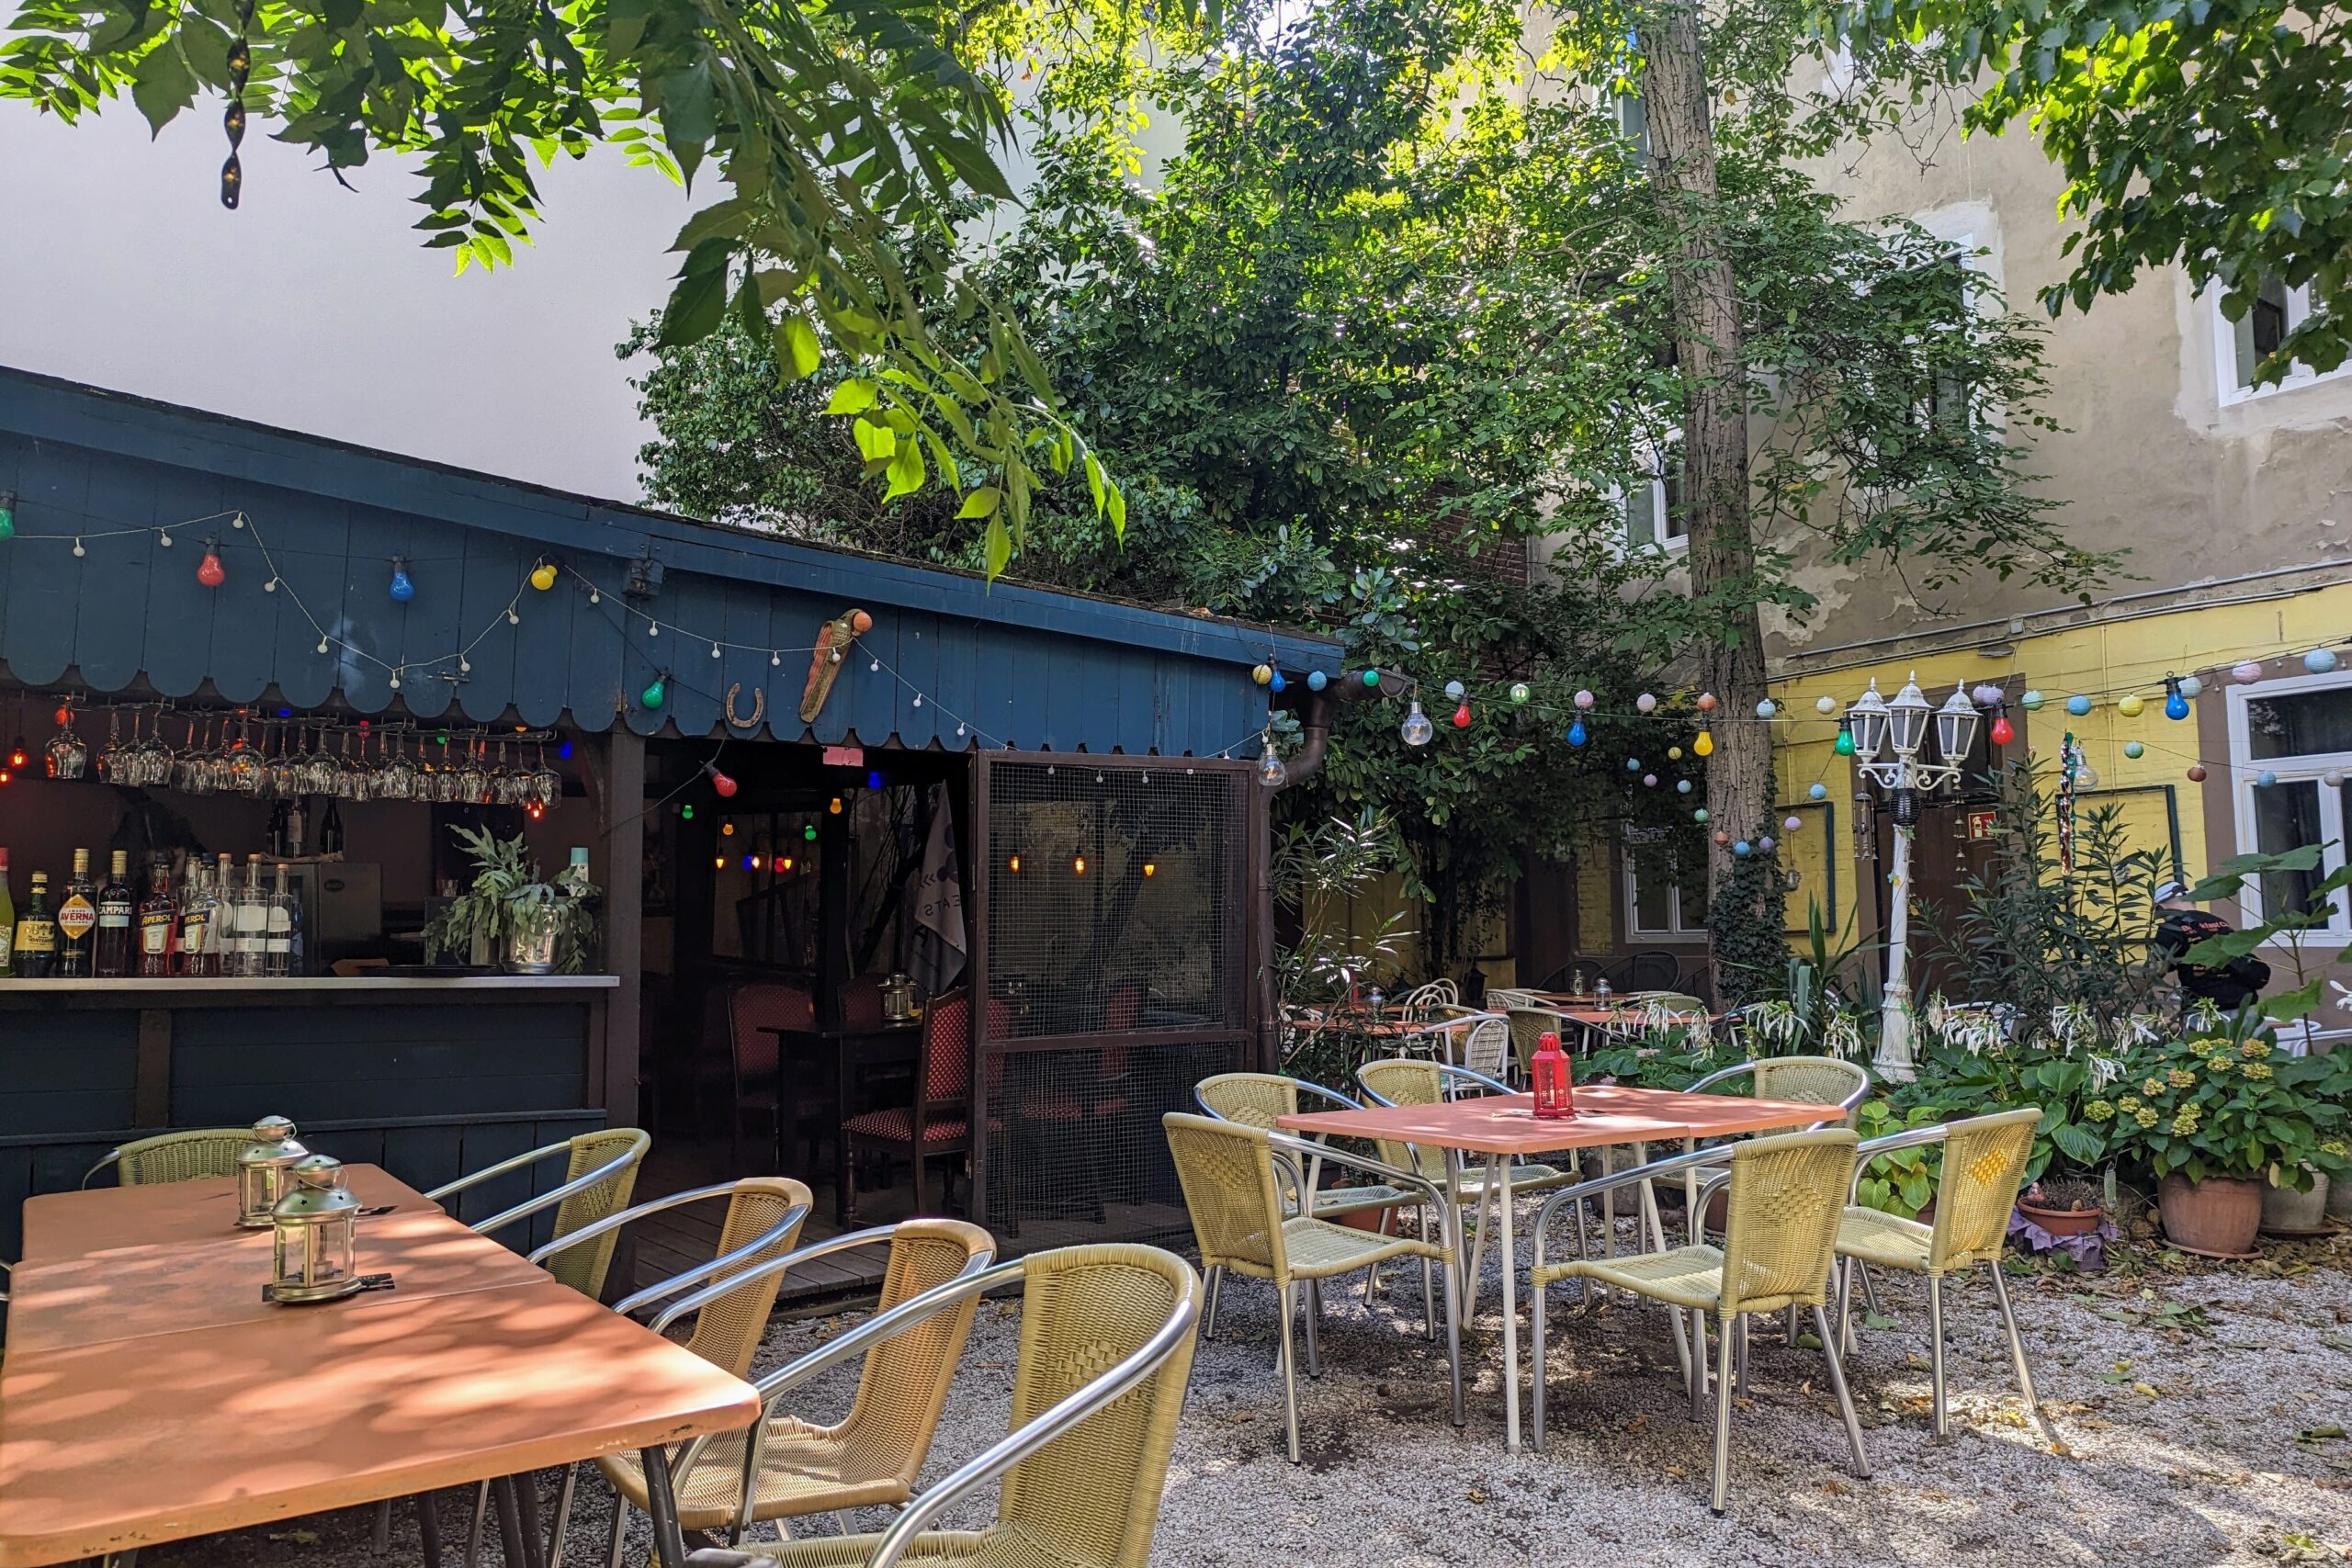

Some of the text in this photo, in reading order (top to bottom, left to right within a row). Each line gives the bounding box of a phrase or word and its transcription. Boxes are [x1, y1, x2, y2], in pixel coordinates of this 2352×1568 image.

[99, 906, 132, 915] CAMPARI
[61, 913, 94, 921] AVERNA
[141, 914, 171, 925] APEROL
[185, 914, 205, 924] PEROL
